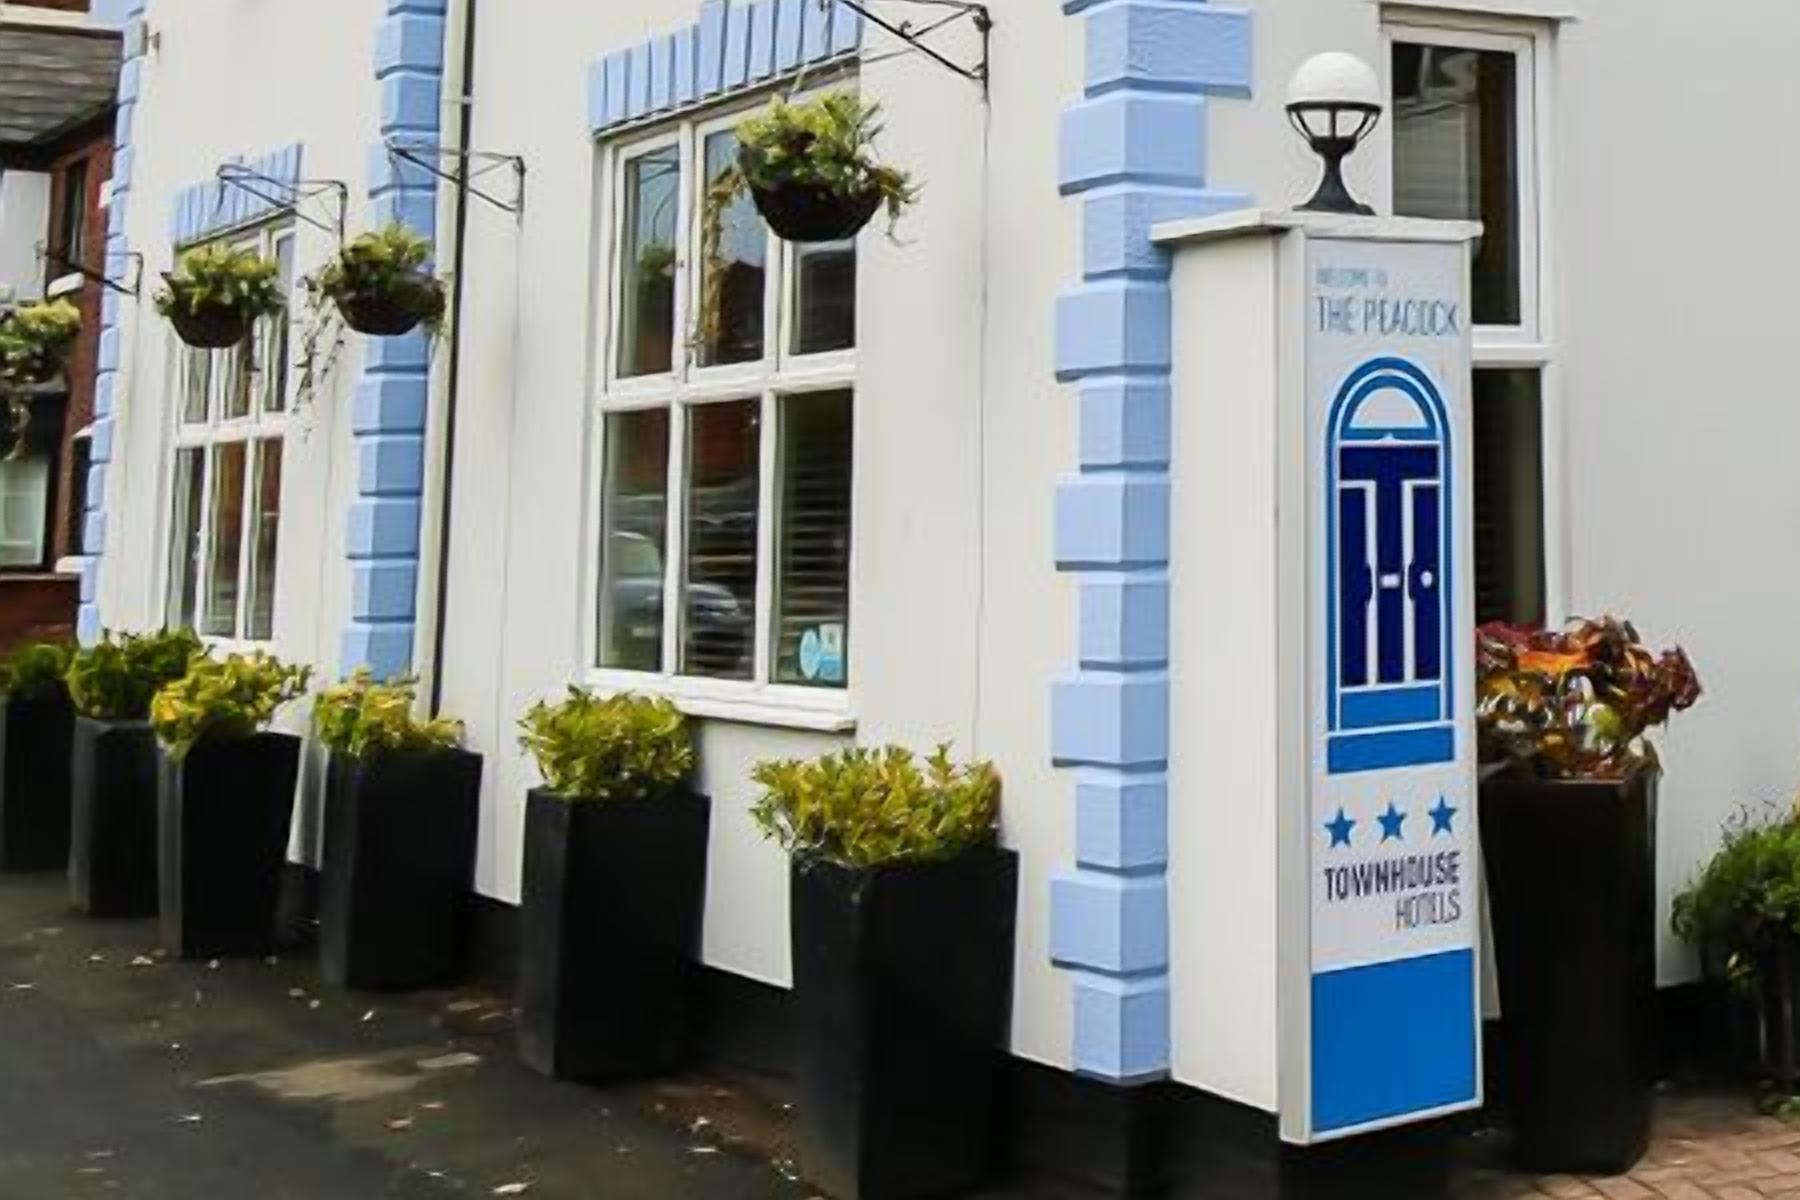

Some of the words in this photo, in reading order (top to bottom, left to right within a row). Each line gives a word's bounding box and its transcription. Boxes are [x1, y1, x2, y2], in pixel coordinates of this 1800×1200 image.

[1316, 295, 1355, 336] THE
[1363, 298, 1460, 337] PEACOCK
[1323, 850, 1461, 902] TOWNHOUSE
[1395, 888, 1462, 931] HOTELS
